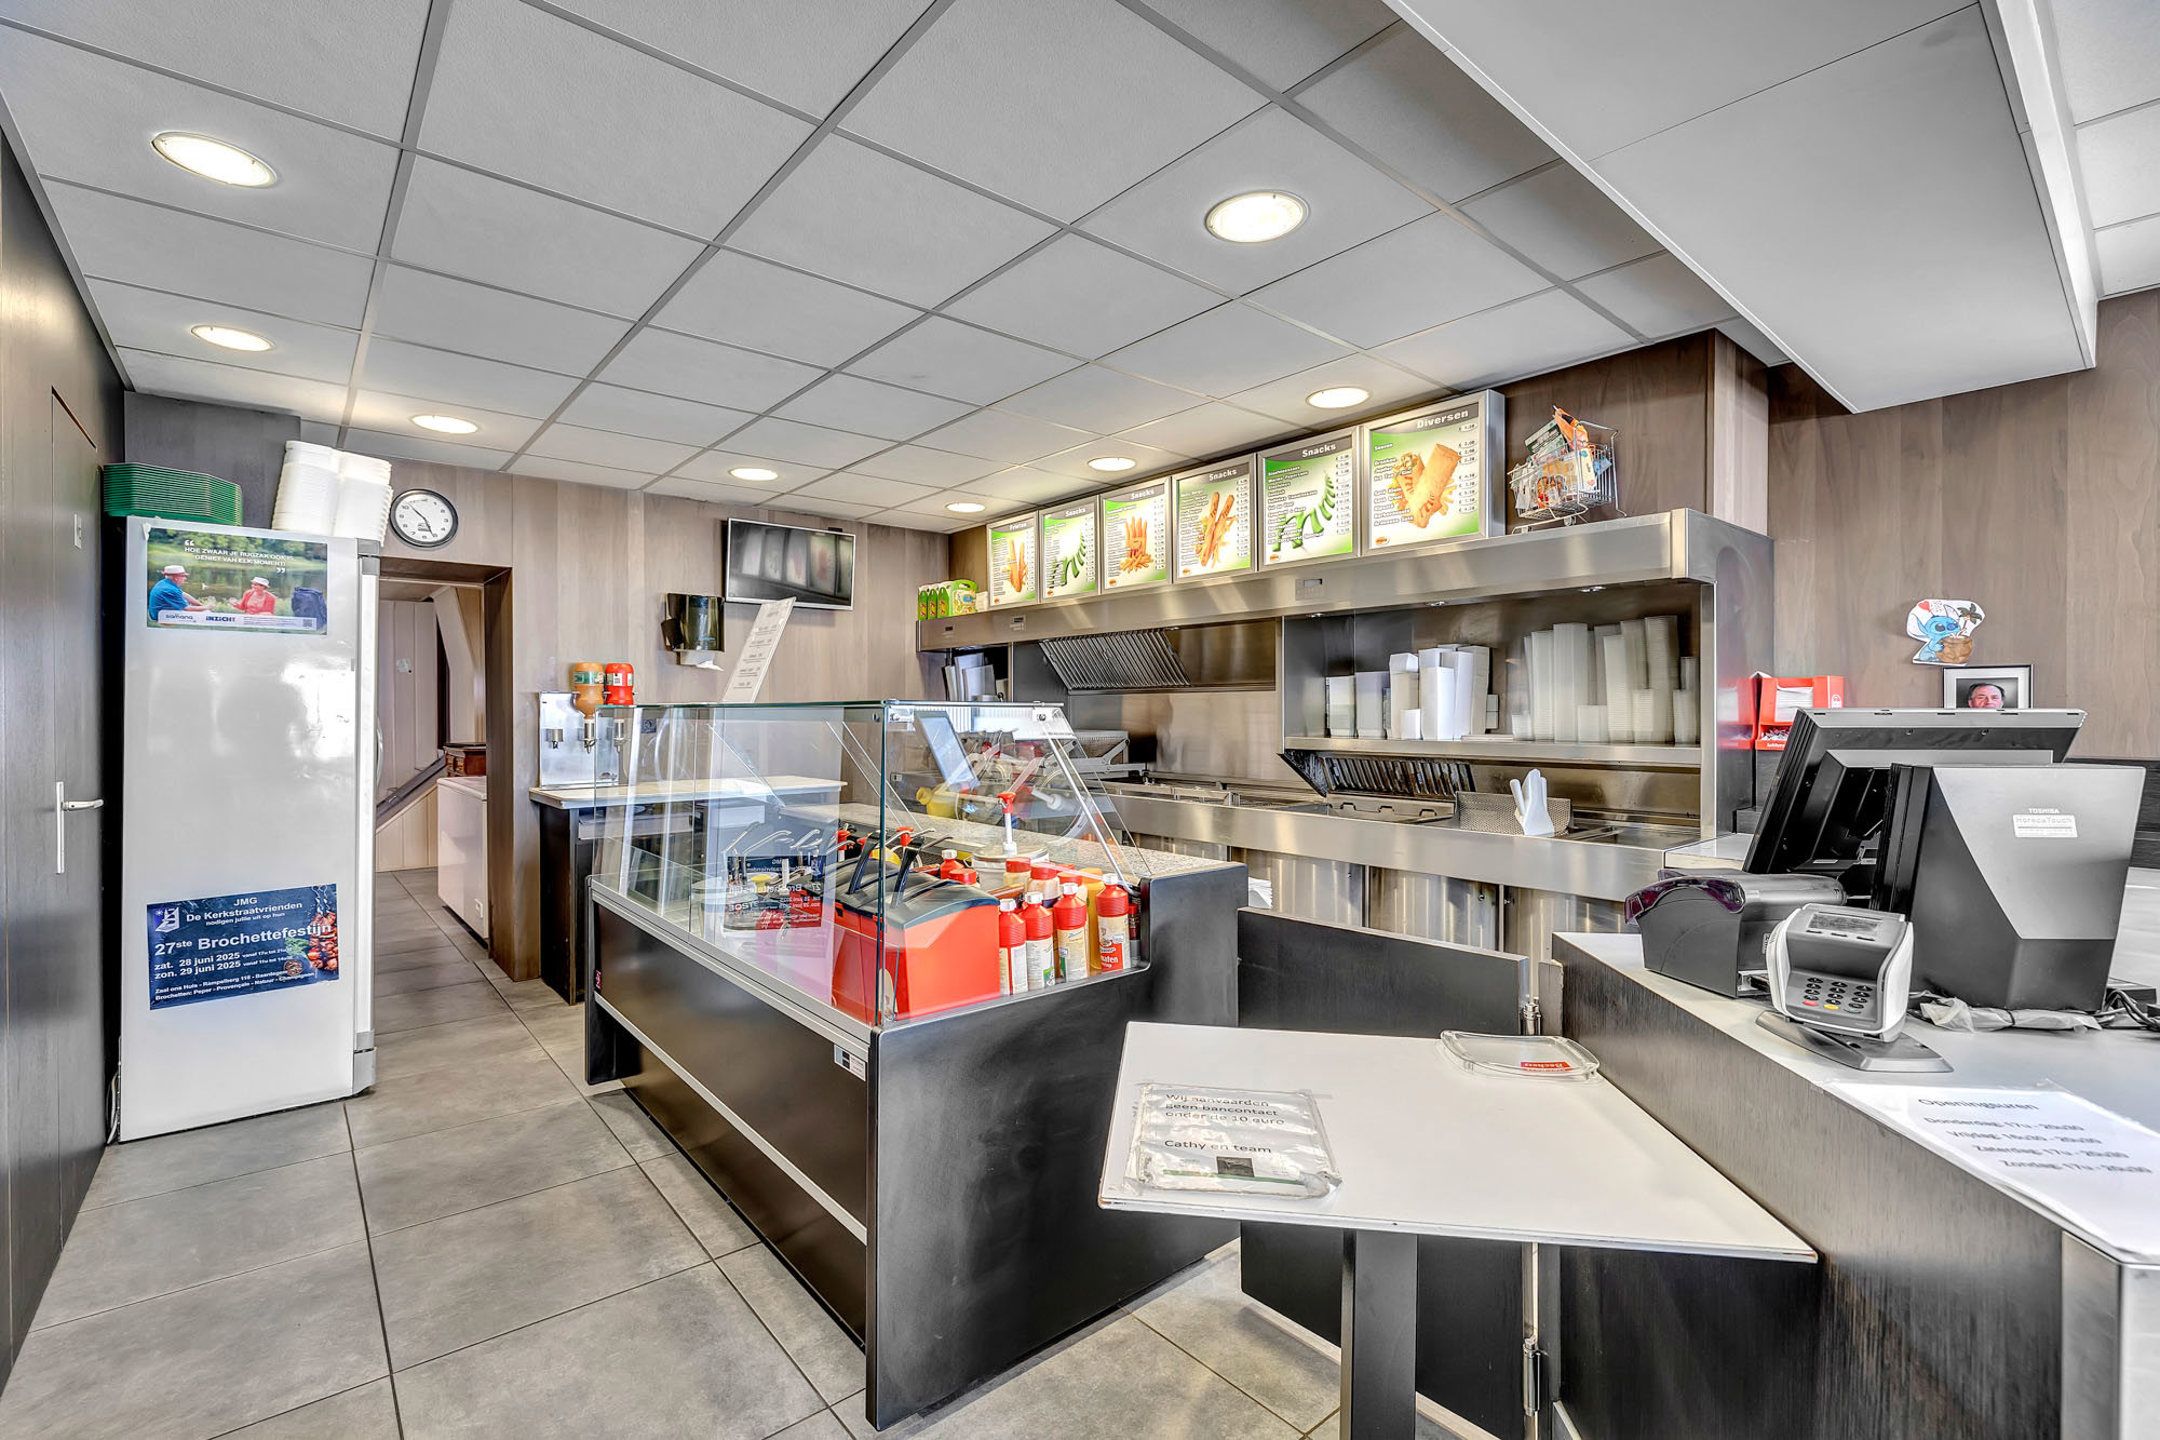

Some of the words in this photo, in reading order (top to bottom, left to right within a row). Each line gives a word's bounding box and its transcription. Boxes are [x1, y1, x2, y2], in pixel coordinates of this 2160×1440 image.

[1416, 410, 1469, 429] Diversen
[1302, 443, 1336, 458] Snacks
[1209, 469, 1237, 481] Snacks
[1131, 488, 1155, 500] Snacks
[234, 897, 258, 906] JMG
[186, 914, 201, 922] De
[204, 902, 303, 920] Kerkstraatvrienden
[205, 917, 234, 926] nodigen
[154, 940, 193, 956] 27ste
[198, 923, 332, 950] Brochettefestijn
[154, 962, 174, 970] zat.
[179, 959, 192, 967] 28
[194, 955, 214, 966] juni
[216, 952, 240, 961] 2025
[154, 970, 177, 979] zon.
[180, 967, 193, 976] 29
[194, 964, 215, 975] juni
[217, 960, 241, 970] 2025
[193, 987, 212, 995] Peper
[1166, 1094, 1187, 1102] Wij
[1191, 1097, 1269, 1107] aanvaarden
[1918, 1099, 2039, 1110] Openingsuren
[1165, 1111, 1207, 1119] onder
[1202, 1104, 1278, 1116] bancontact
[1164, 1140, 1206, 1150] Cathy
[1233, 1144, 1272, 1153] team
